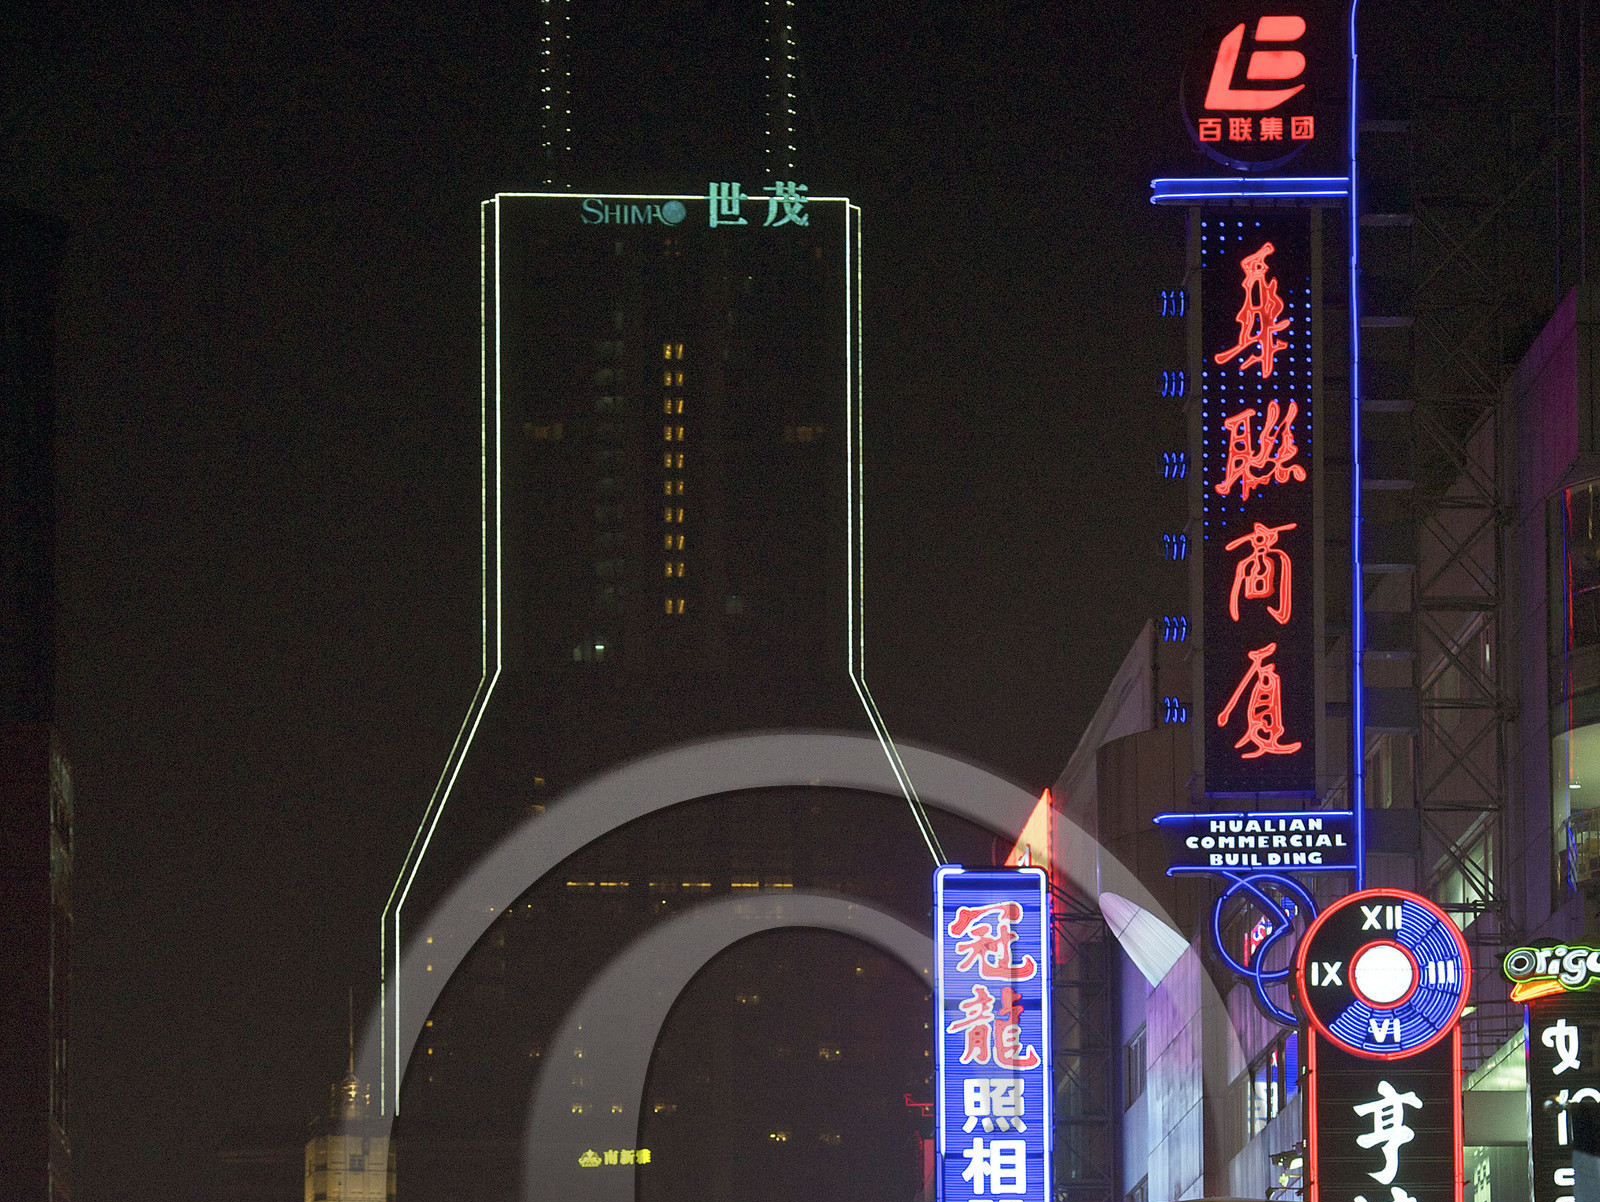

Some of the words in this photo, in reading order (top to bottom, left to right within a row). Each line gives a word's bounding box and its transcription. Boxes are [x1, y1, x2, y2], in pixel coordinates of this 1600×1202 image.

[1198, 115, 1314, 141] 百联集团
[703, 180, 809, 228] 世茂
[1210, 818, 1323, 833] HUALIAN
[1185, 834, 1347, 849] COMMERCIAL
[1360, 905, 1402, 930] XII
[1311, 961, 1343, 987] IX
[1427, 960, 1455, 984] III
[1369, 1018, 1401, 1043] VI
